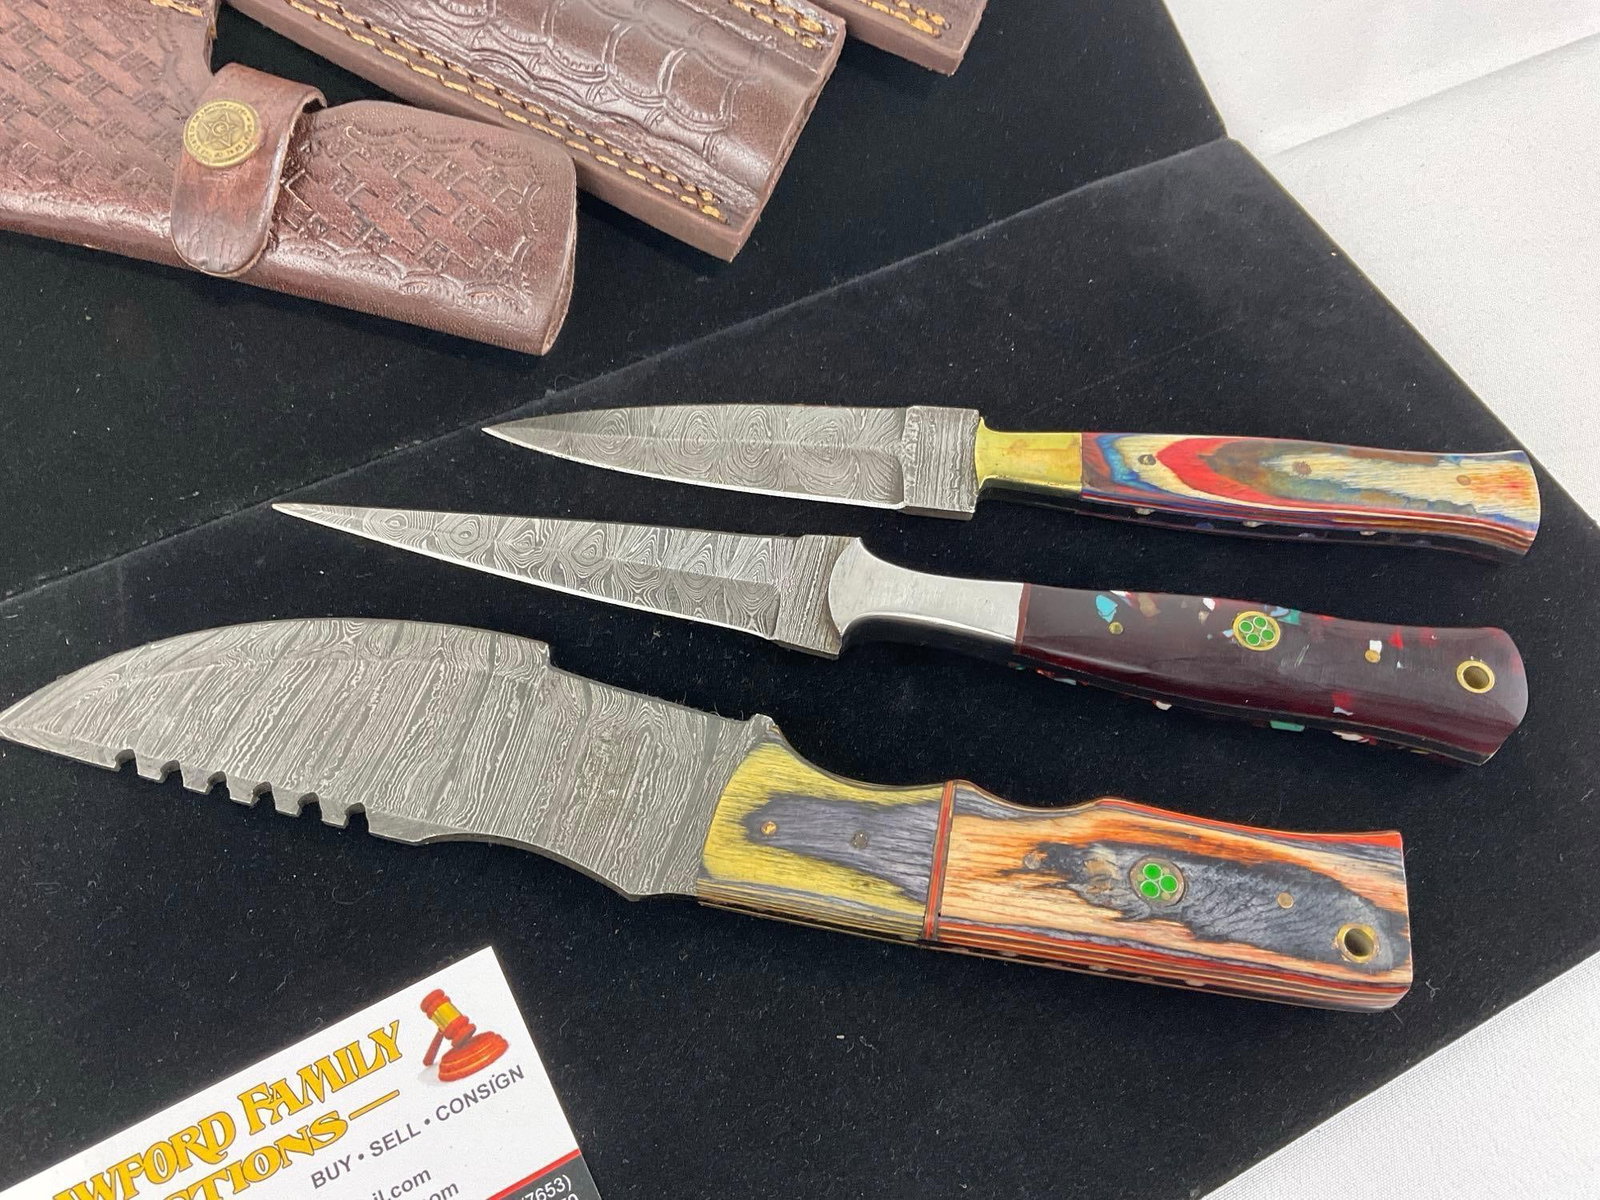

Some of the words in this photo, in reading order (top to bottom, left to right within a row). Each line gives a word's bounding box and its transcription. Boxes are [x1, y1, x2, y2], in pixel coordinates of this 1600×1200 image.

[53, 1111, 236, 1200] WFORD
[237, 1020, 402, 1135] FAMILY
[311, 1154, 351, 1189] BUY
[369, 1123, 421, 1157] SELL
[435, 1064, 524, 1121] CONSIGN
[422, 1183, 459, 1200] om
[521, 1174, 571, 1200] 7653)
